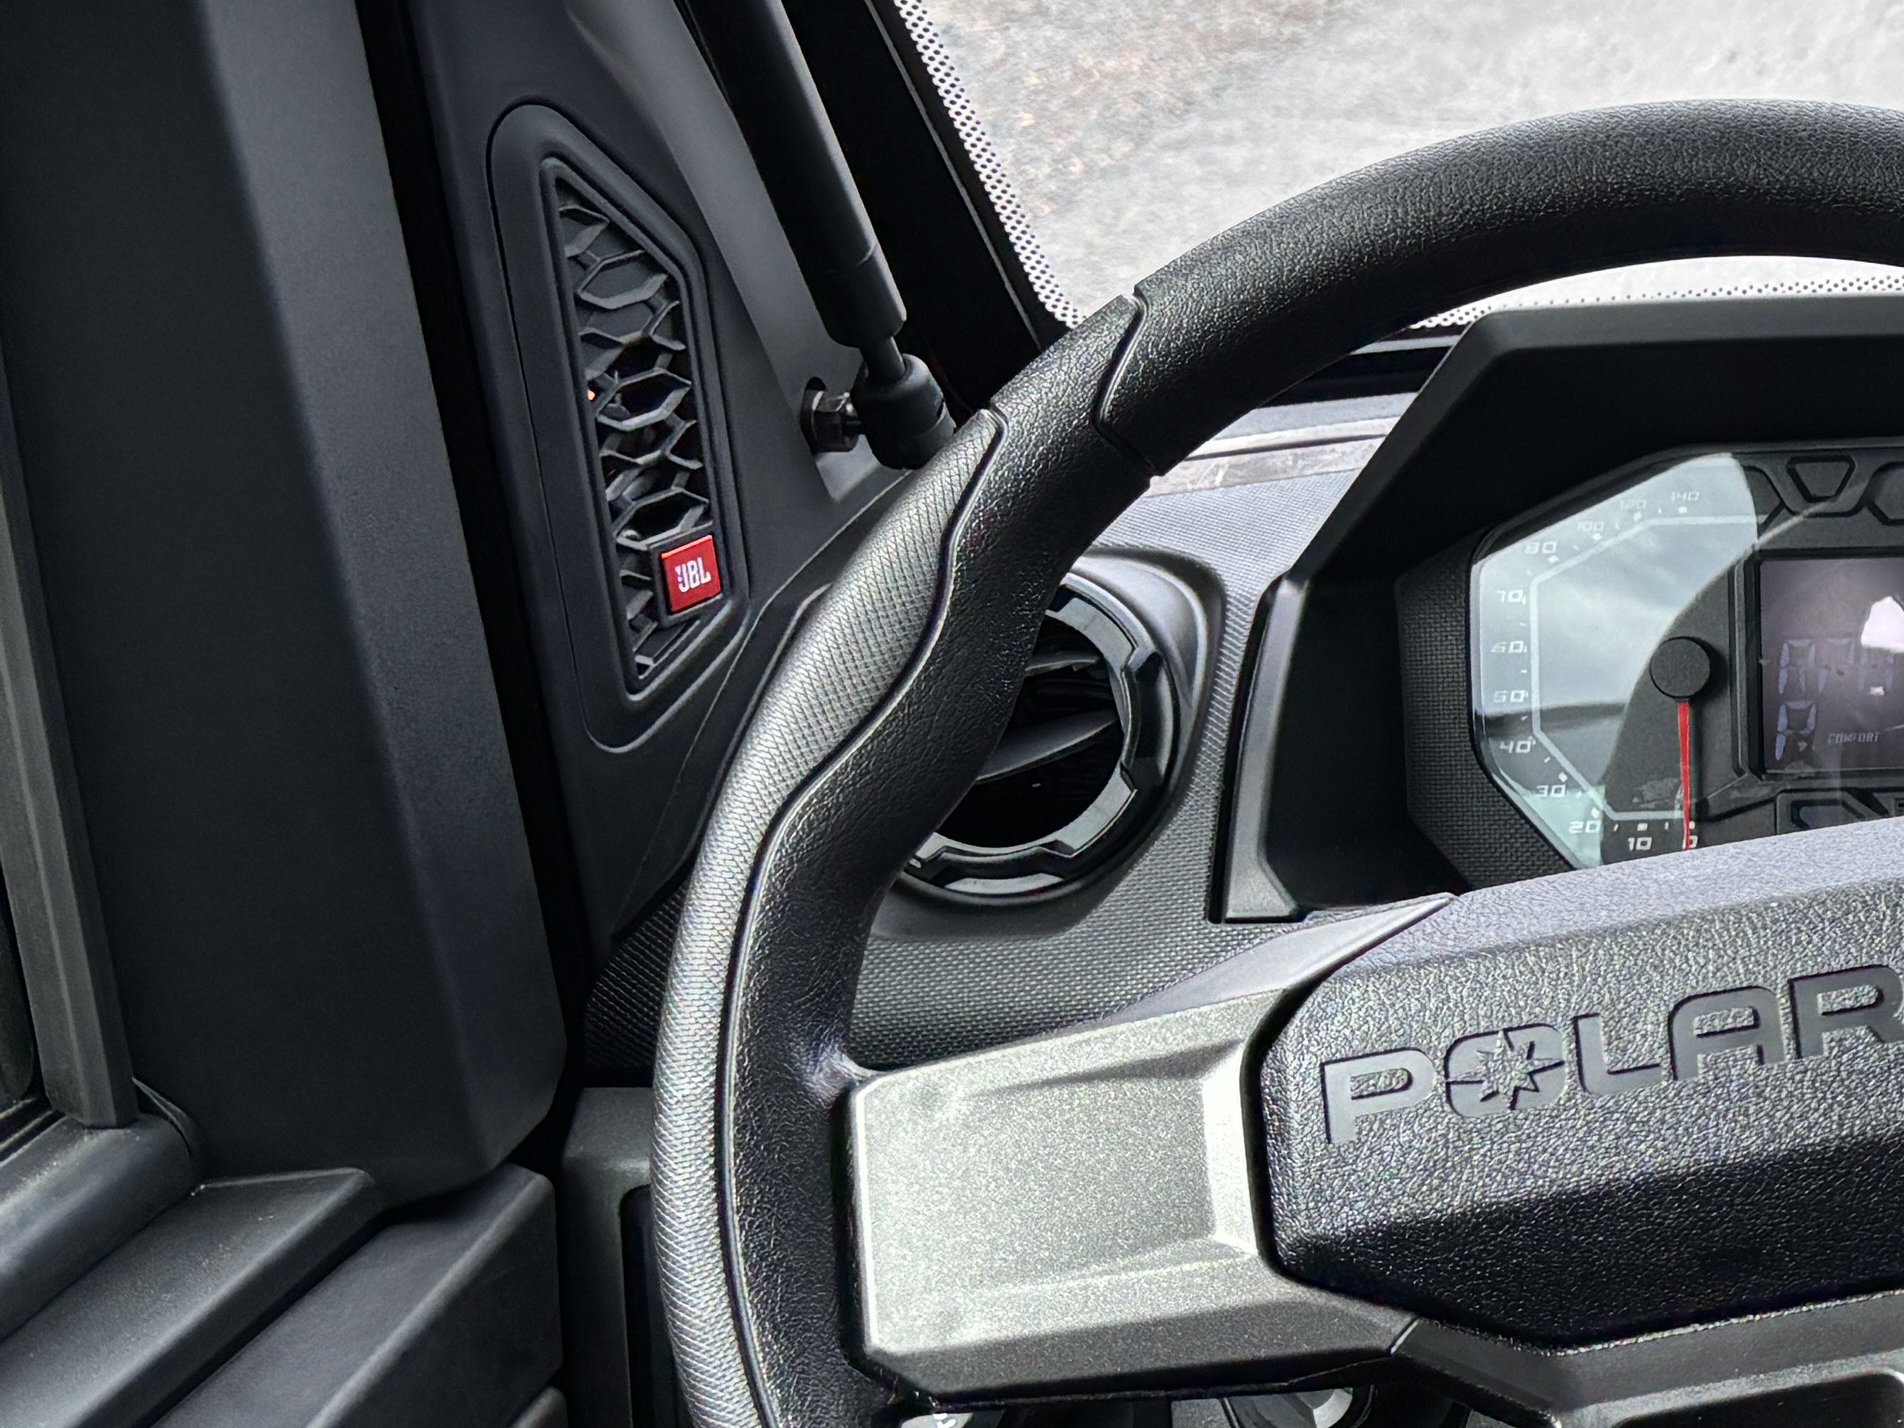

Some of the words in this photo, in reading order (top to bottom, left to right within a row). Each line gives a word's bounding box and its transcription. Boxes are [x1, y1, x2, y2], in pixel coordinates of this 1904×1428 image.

[1524, 541, 1558, 555] 80
[674, 557, 712, 593] JBL
[1534, 785, 1566, 799] 30
[1568, 820, 1602, 834] 20
[1627, 836, 1652, 852] 10
